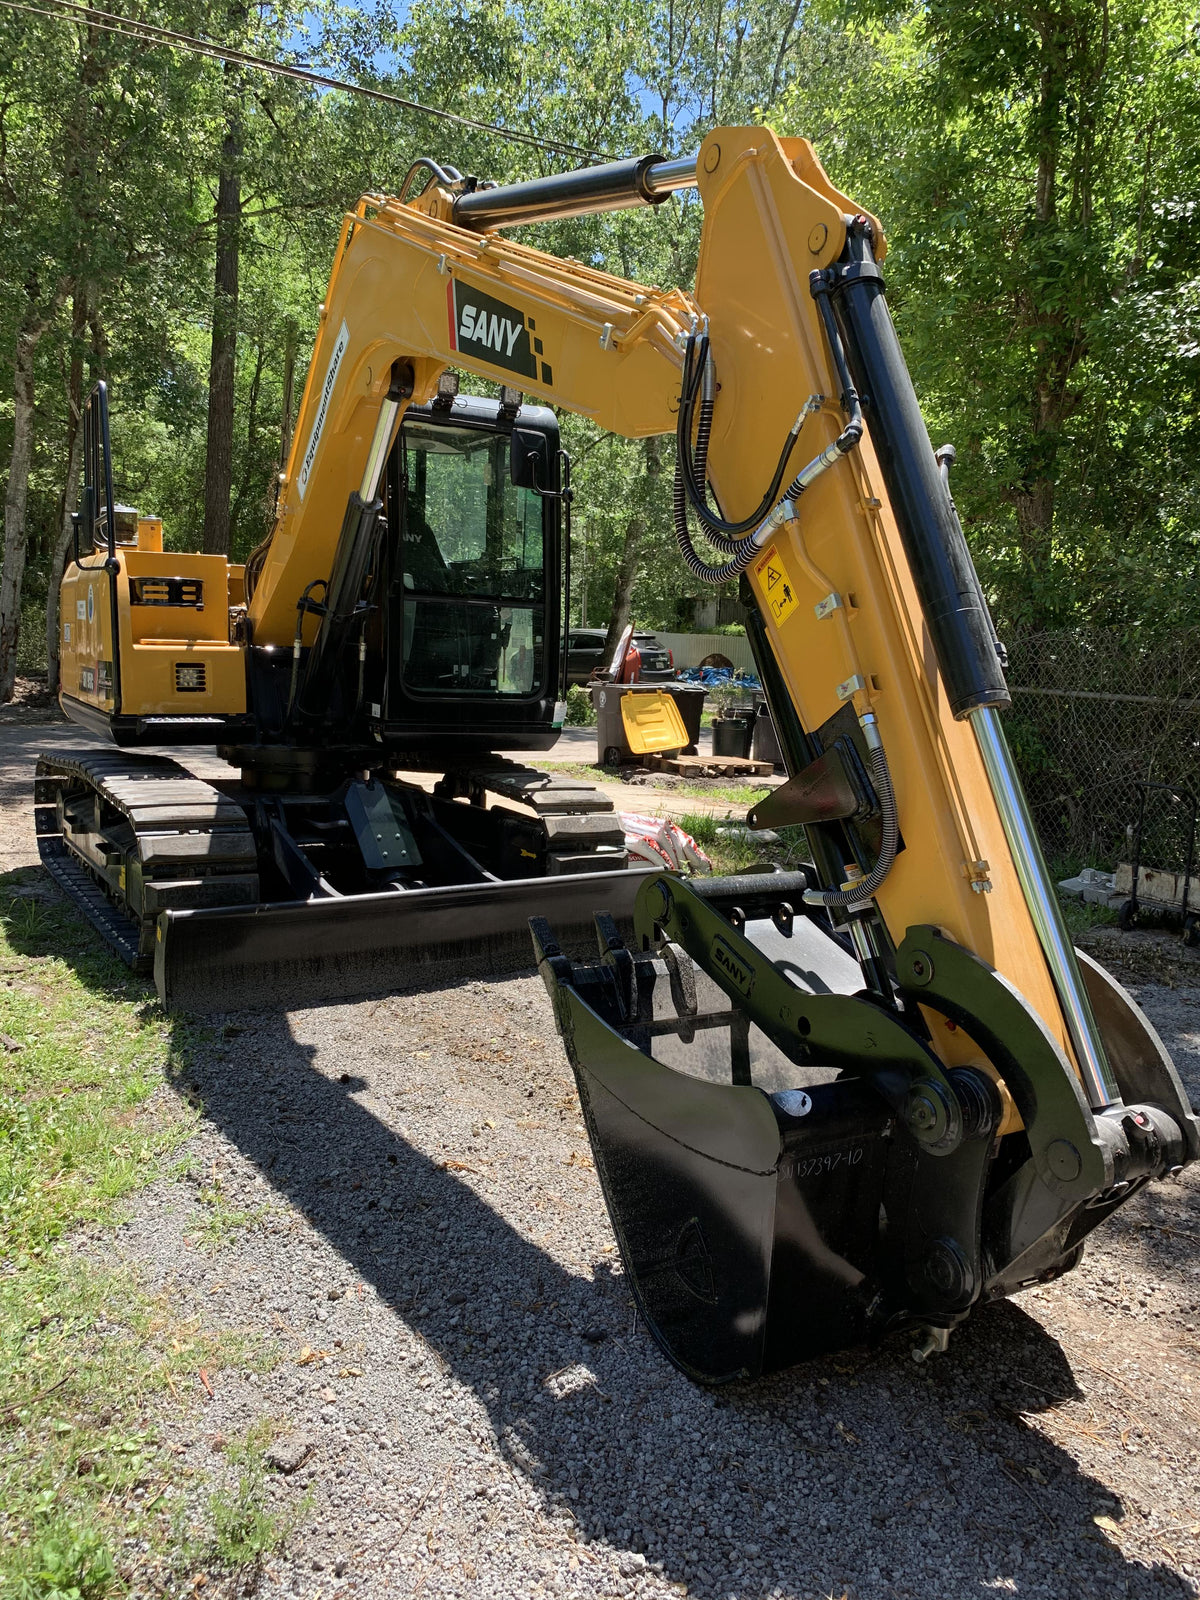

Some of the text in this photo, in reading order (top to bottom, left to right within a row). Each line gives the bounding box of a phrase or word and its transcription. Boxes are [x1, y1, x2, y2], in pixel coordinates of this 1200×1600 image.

[460, 304, 523, 357] SANY
[305, 341, 344, 468] EquipmentShare
[715, 948, 747, 985] SANY
[797, 1147, 863, 1177] 137397-10
